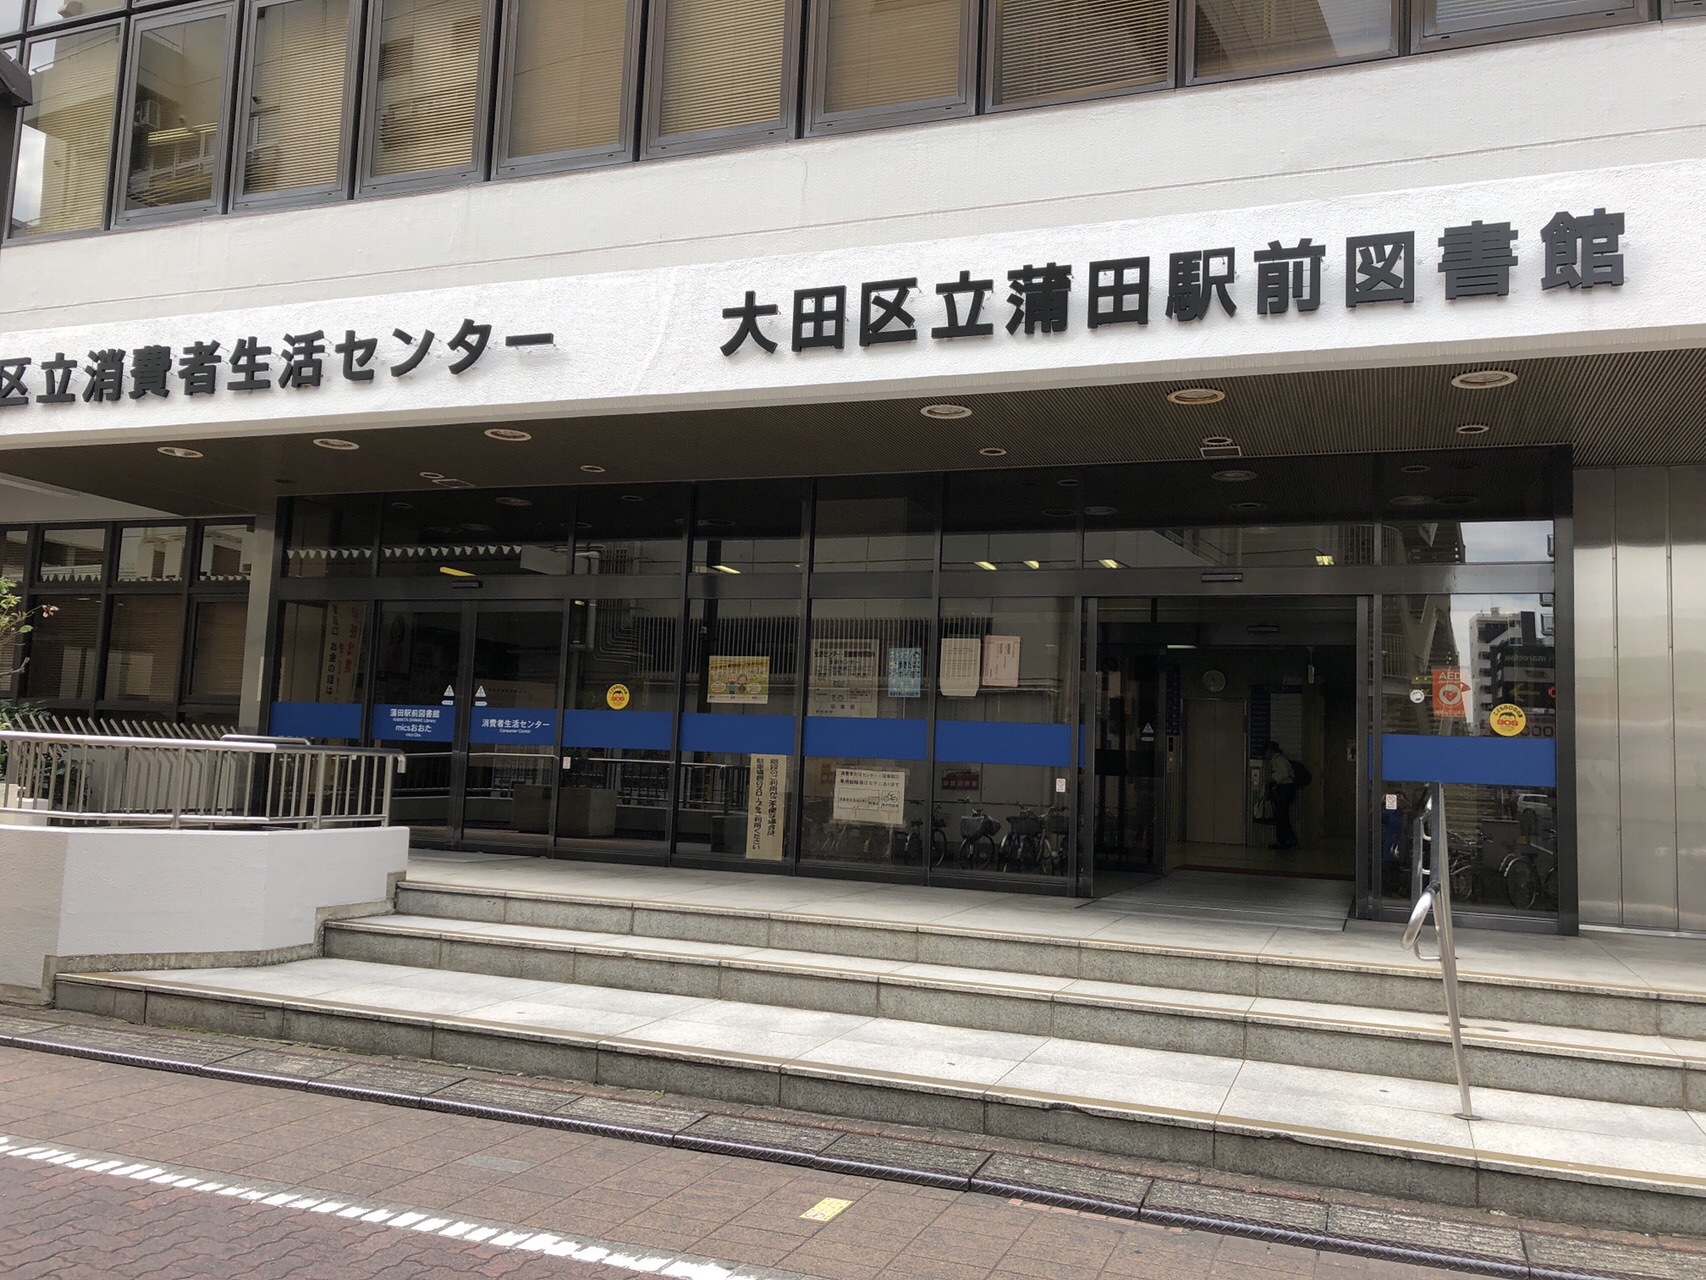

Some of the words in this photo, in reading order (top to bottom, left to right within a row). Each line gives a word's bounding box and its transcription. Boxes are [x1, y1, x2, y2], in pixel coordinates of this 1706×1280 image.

[721, 208, 1625, 357] 大田区立蒲田駅前図書館
[390, 708, 440, 718] 蒲田駅前図書館
[395, 723, 432, 733] micsおおた
[481, 718, 550, 729] 消費者生活センター
[1496, 719, 1519, 727] SOS
